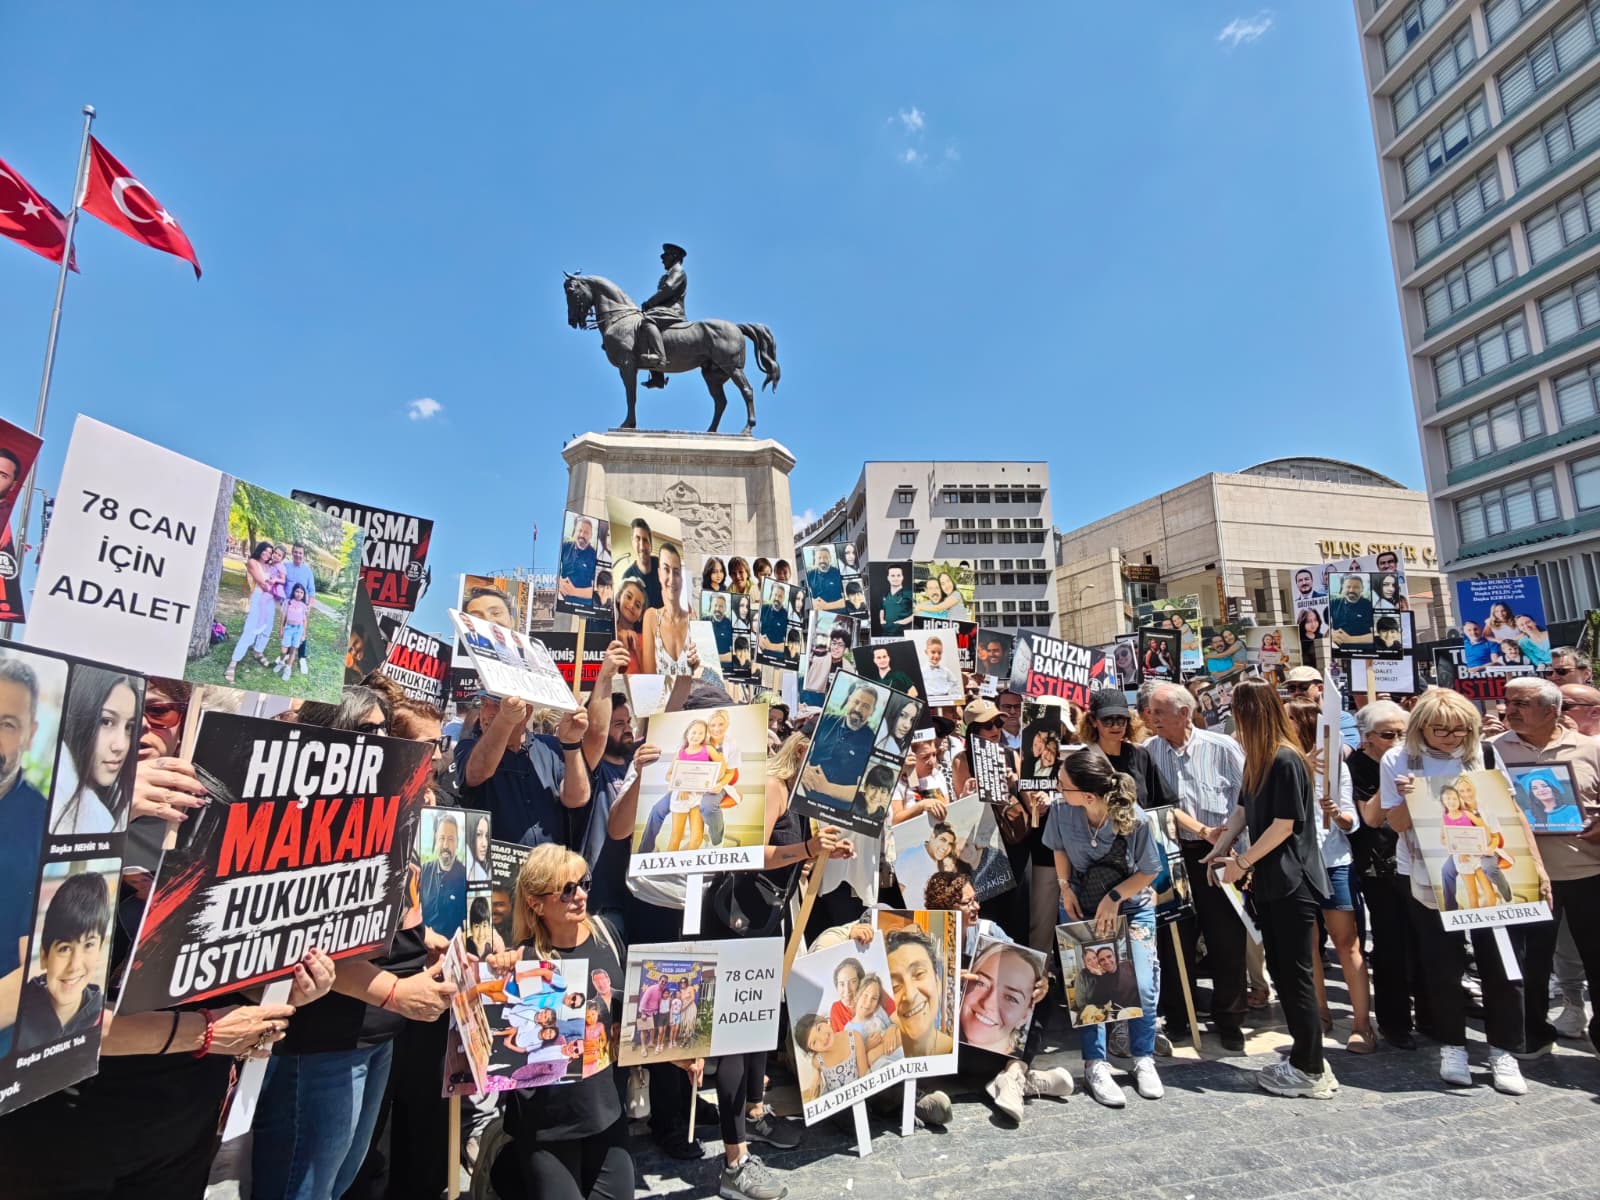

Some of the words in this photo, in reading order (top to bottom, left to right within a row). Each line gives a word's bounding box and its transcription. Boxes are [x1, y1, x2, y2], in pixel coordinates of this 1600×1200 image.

[82, 490, 120, 521] 78
[129, 508, 197, 546] CAN
[98, 535, 165, 578] İÇİN
[48, 575, 191, 624] ADALET
[583, 650, 606, 661] DALE
[1031, 634, 1092, 669] TURİZM
[386, 666, 439, 695] HUKUKTAN
[1033, 655, 1089, 686] BAKANI
[1026, 668, 1091, 709] İSTİFA!
[242, 729, 384, 809] HİÇBİR
[215, 796, 401, 877] MAKAM
[638, 856, 677, 870] ALYA
[680, 859, 693, 868] ve
[695, 850, 751, 867] KÜBRA
[221, 864, 380, 932] HUKUKTAN
[1451, 912, 1482, 925] ALYA
[1497, 906, 1541, 921] KÜBRA
[168, 929, 280, 997] ÜSTÜN
[283, 904, 392, 967] DEĞİLDİR!
[725, 970, 742, 983] 78
[744, 968, 775, 981] CAN
[734, 987, 763, 1005] İÇİN
[718, 1008, 776, 1025] ADALET
[0, 1081, 21, 1104] yok
[806, 1060, 928, 1120] ELA-DEFNE-DİLAURA
